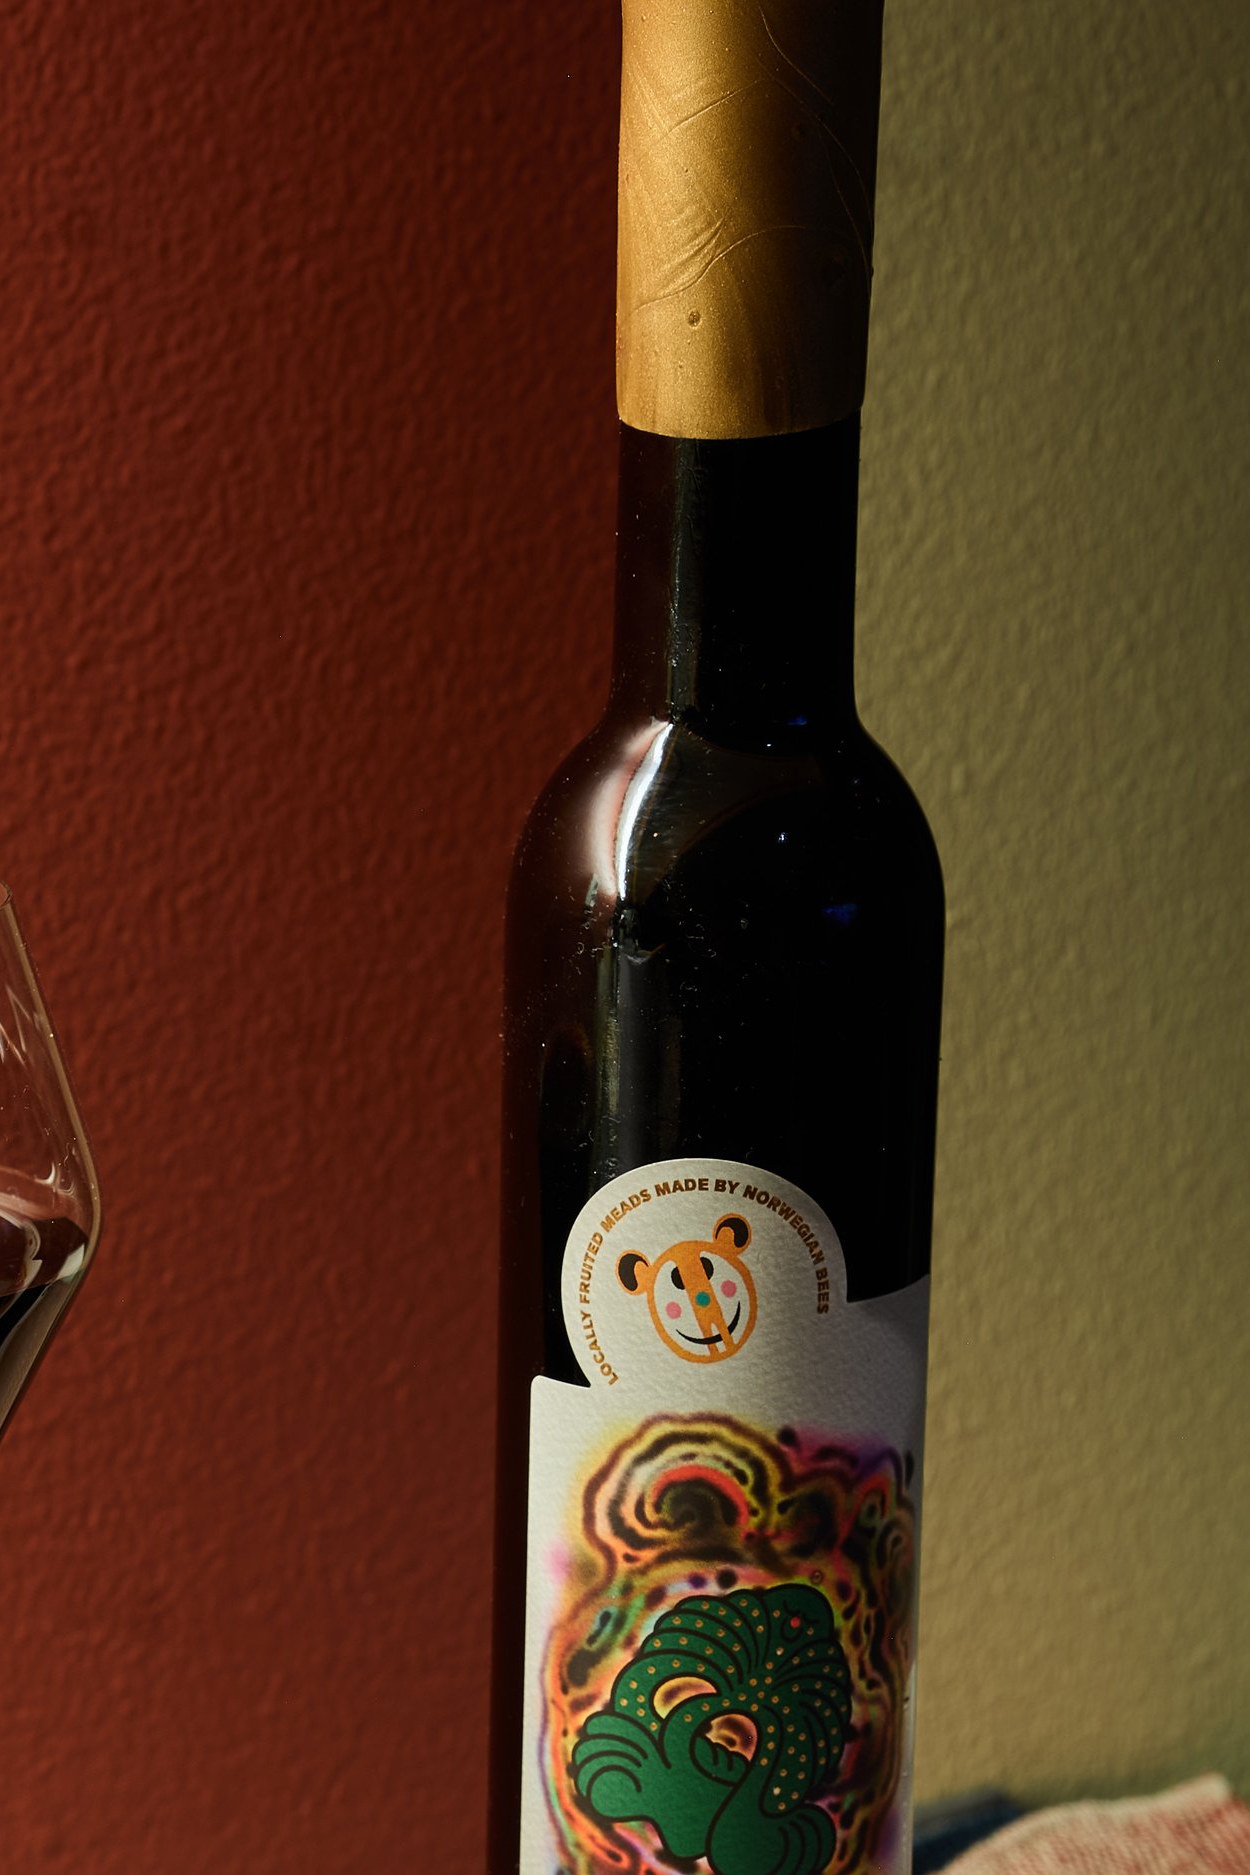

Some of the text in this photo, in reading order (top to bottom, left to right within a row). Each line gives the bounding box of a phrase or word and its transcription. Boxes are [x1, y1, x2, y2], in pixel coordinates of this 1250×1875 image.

[579, 1178, 830, 1386] LOCALLY FRUITED MEADS MADE BY NORWEGIAN BEES
